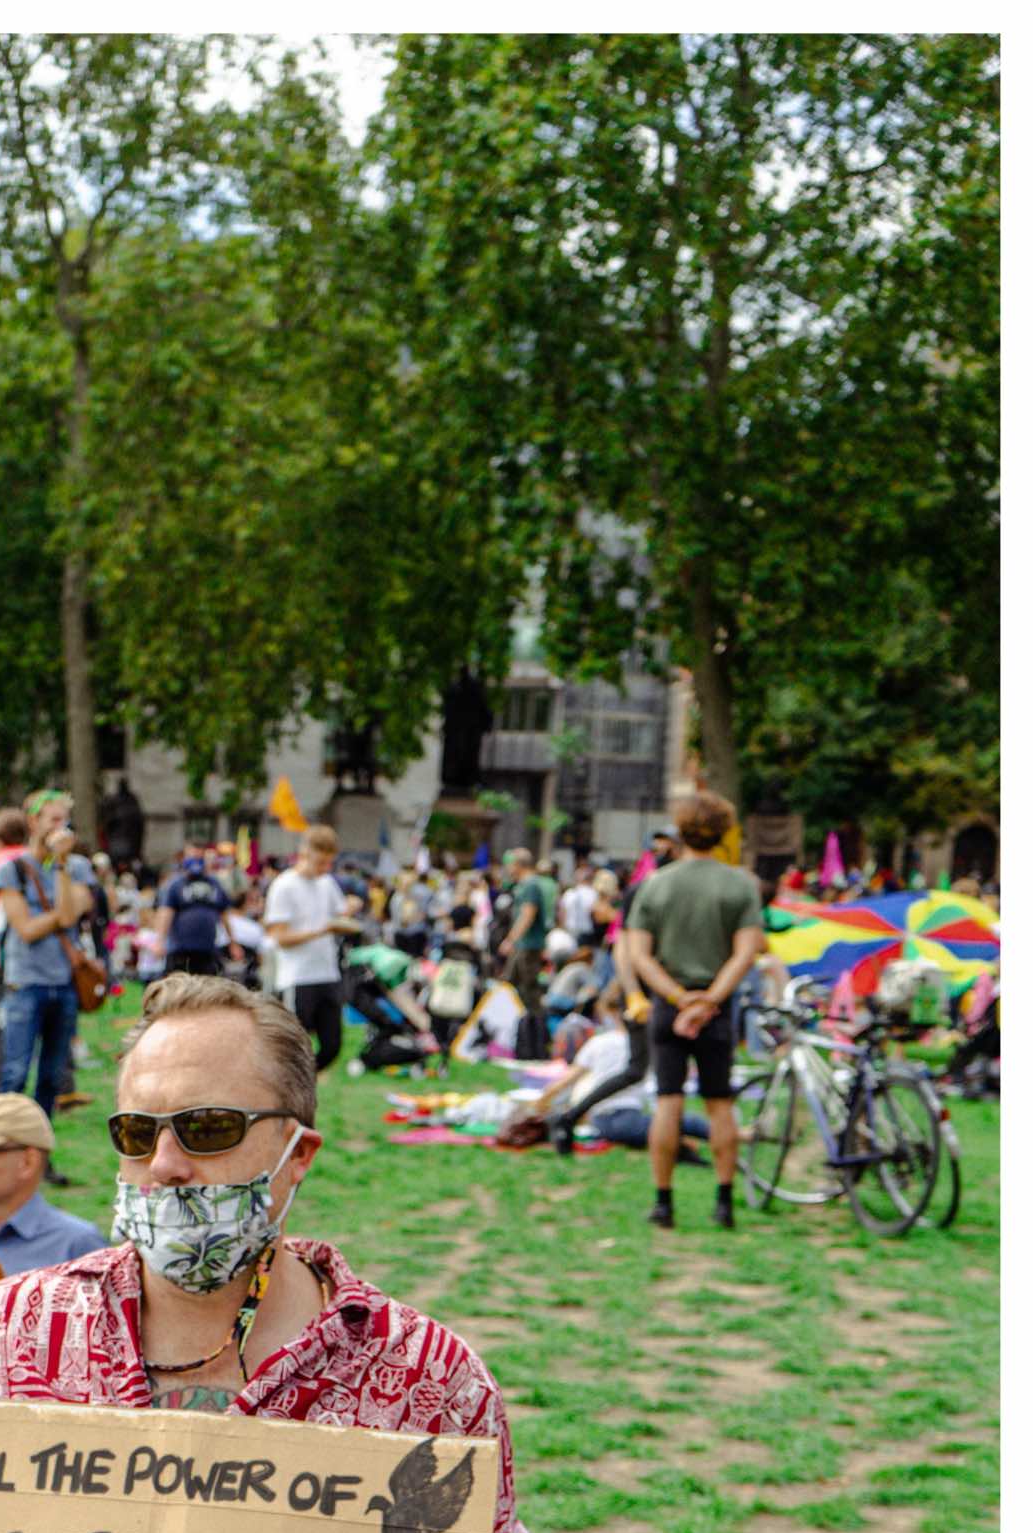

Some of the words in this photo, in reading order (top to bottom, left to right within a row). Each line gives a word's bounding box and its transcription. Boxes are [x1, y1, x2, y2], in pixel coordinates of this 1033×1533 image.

[30, 1441, 116, 1494] THE
[124, 1445, 276, 1502] POWER
[288, 1472, 363, 1516] OF
